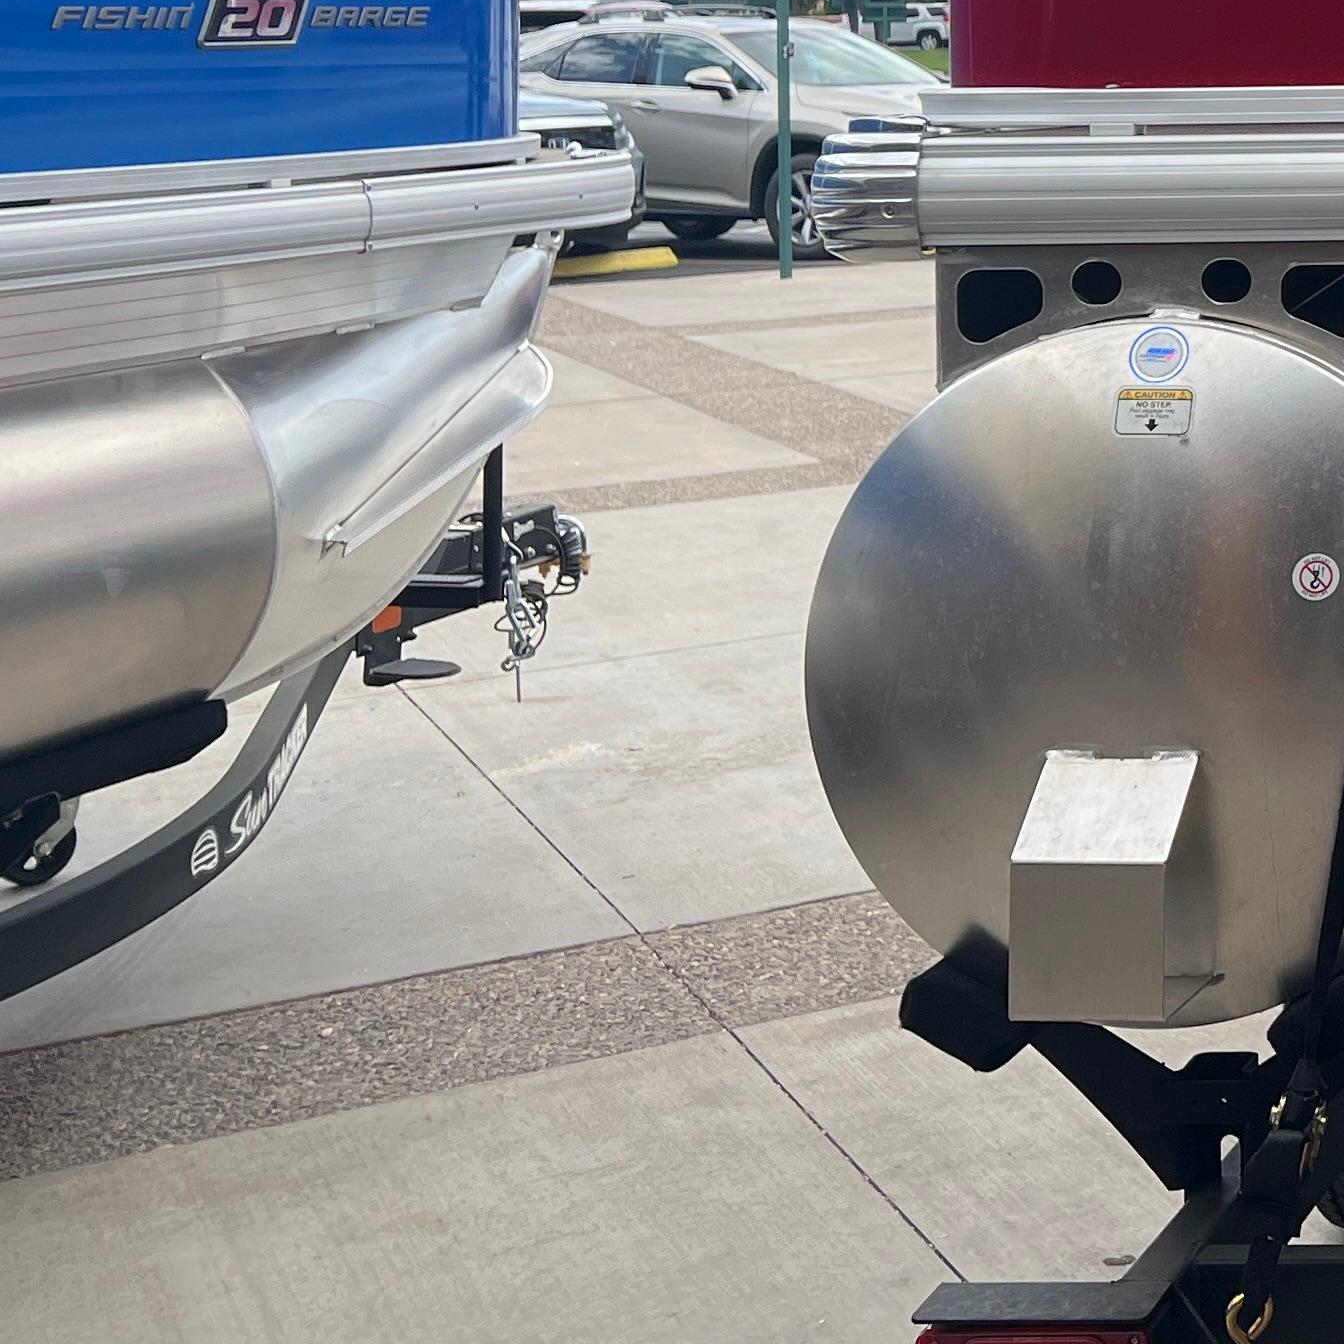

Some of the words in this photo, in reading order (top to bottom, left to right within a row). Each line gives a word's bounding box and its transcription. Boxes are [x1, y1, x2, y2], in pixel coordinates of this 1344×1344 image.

[217, 0, 297, 38] 20
[310, 6, 431, 28] BARGE
[1134, 391, 1176, 399] CAUTION
